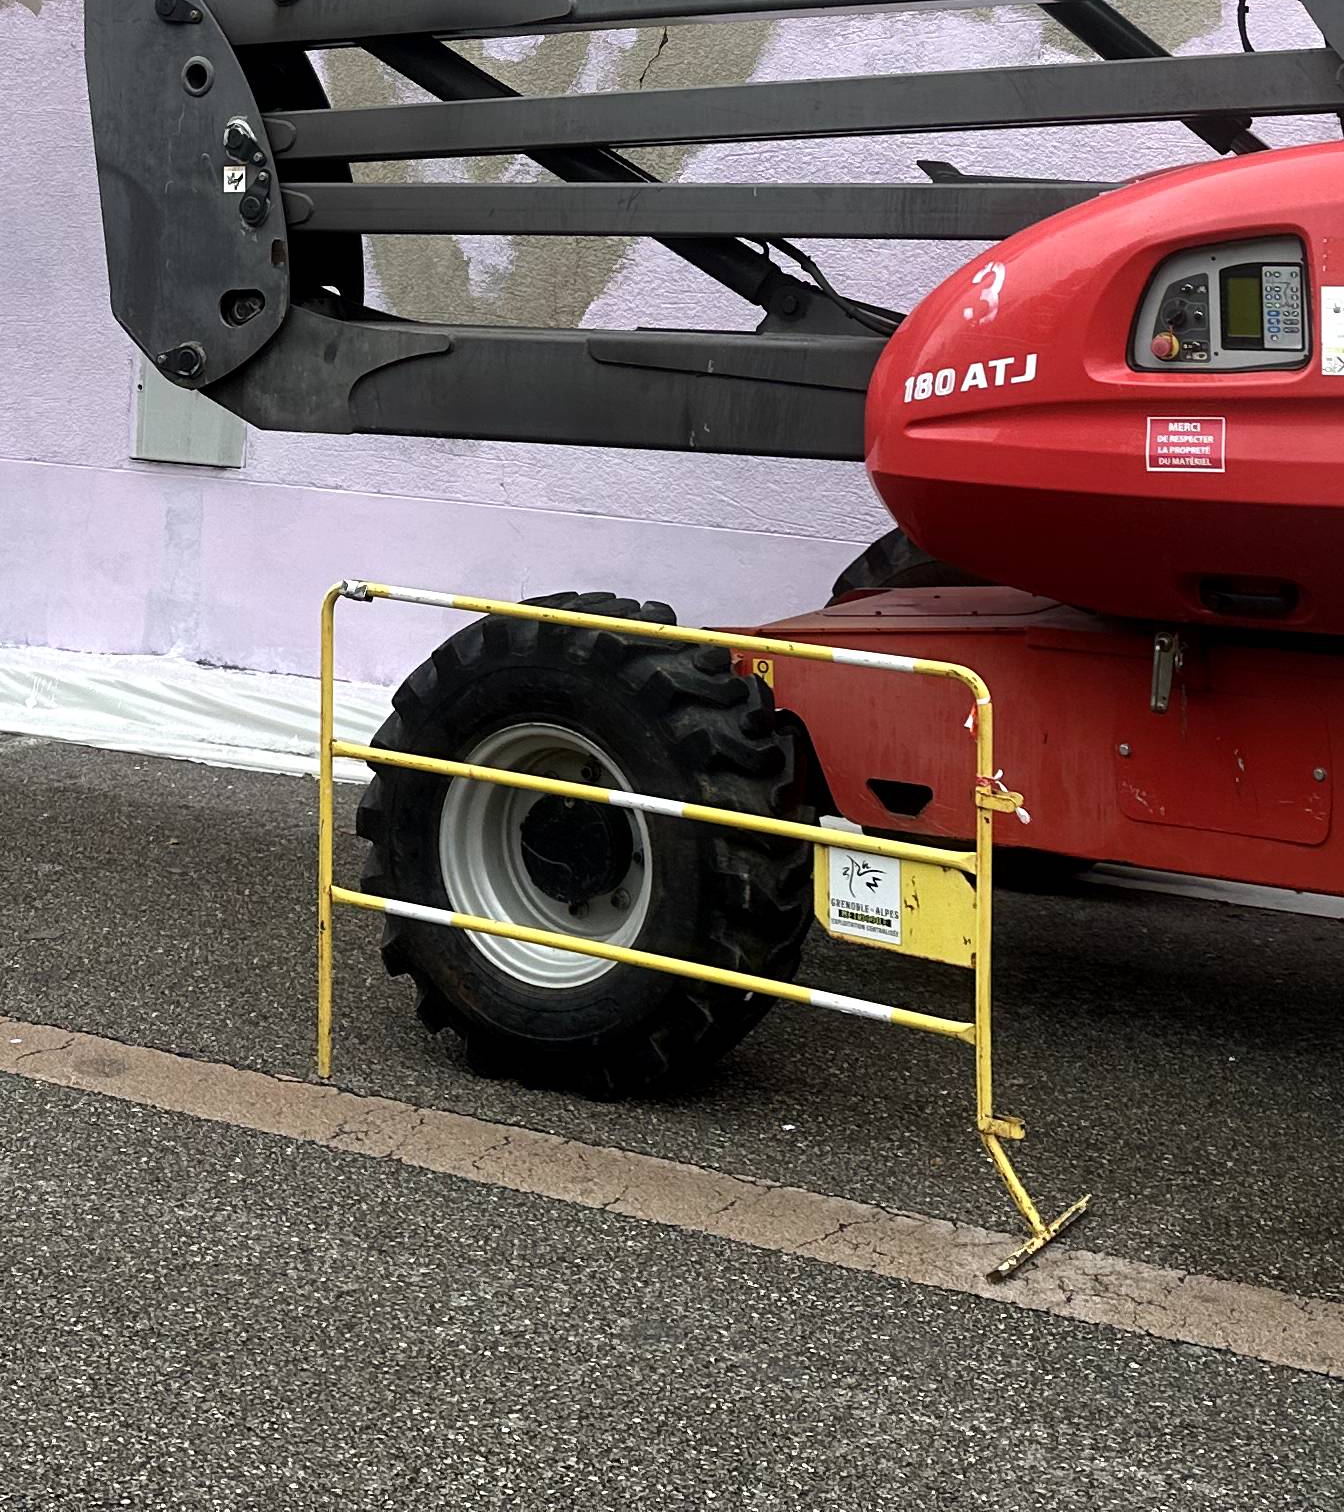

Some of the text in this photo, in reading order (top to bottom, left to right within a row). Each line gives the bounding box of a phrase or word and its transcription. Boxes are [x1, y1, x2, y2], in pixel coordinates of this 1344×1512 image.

[963, 261, 1006, 327] 3
[903, 354, 1038, 403] 180 ATJ
[1168, 422, 1201, 432] MERCI
[1157, 435, 1214, 443] DE RESPECTER
[1157, 446, 1168, 454] LA
[1158, 457, 1170, 465] DU
